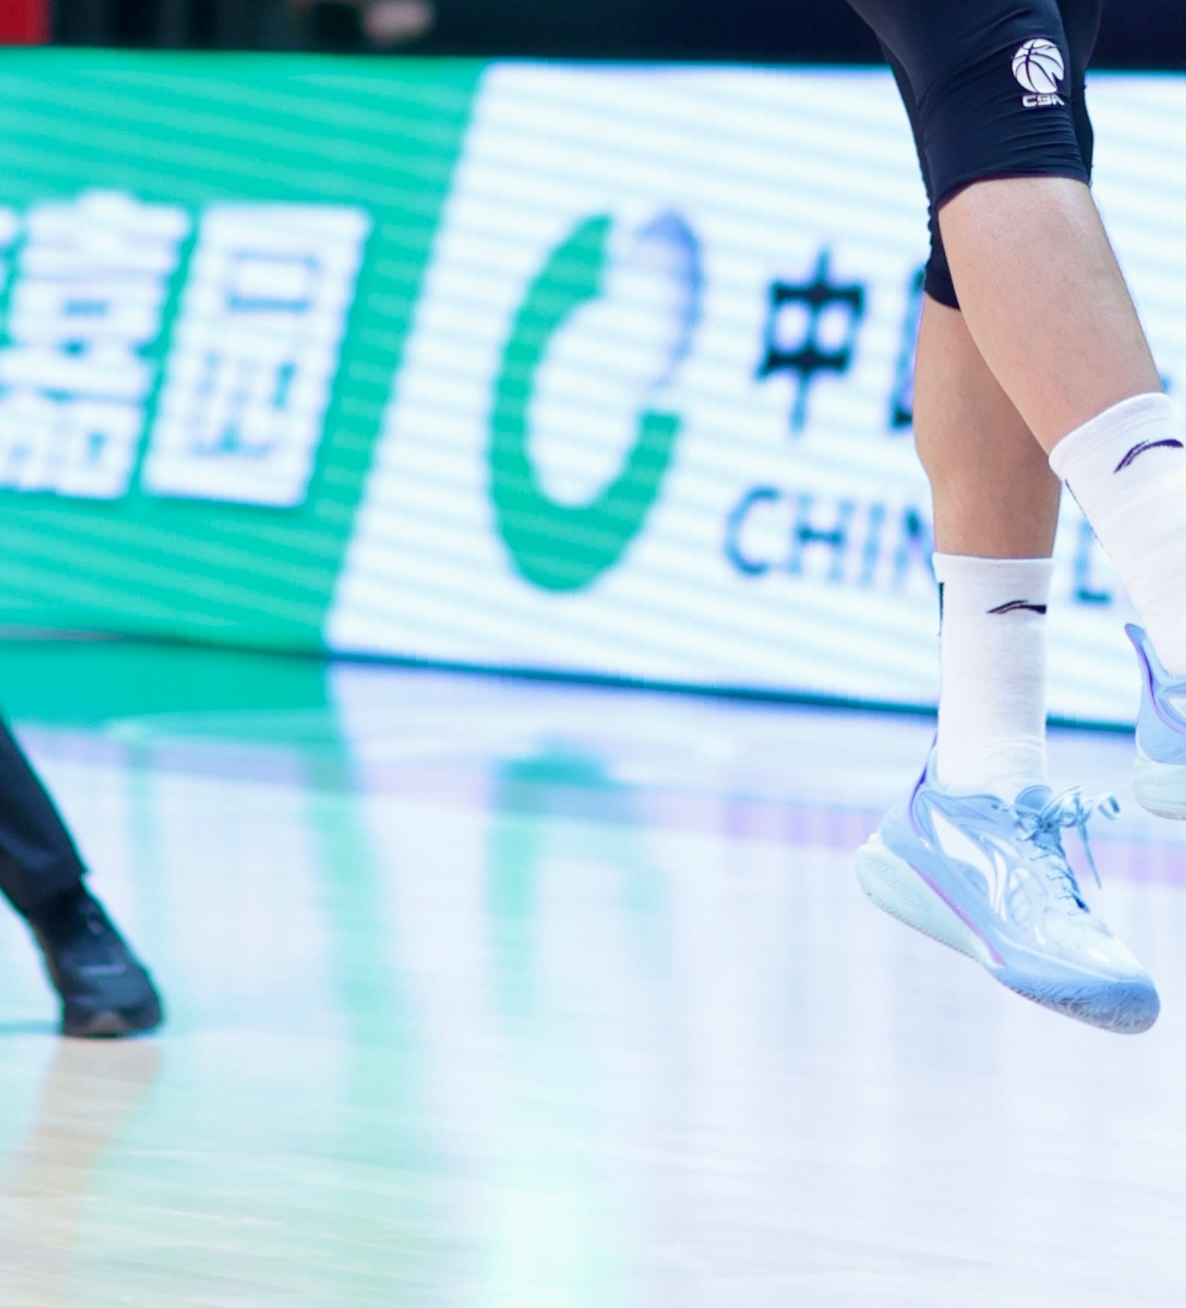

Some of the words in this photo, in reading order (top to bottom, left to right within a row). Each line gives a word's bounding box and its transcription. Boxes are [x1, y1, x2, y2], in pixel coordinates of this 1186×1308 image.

[1022, 93, 1065, 108] CBA
[0, 189, 372, 507] 嘉园
[724, 485, 940, 589] CHIN
